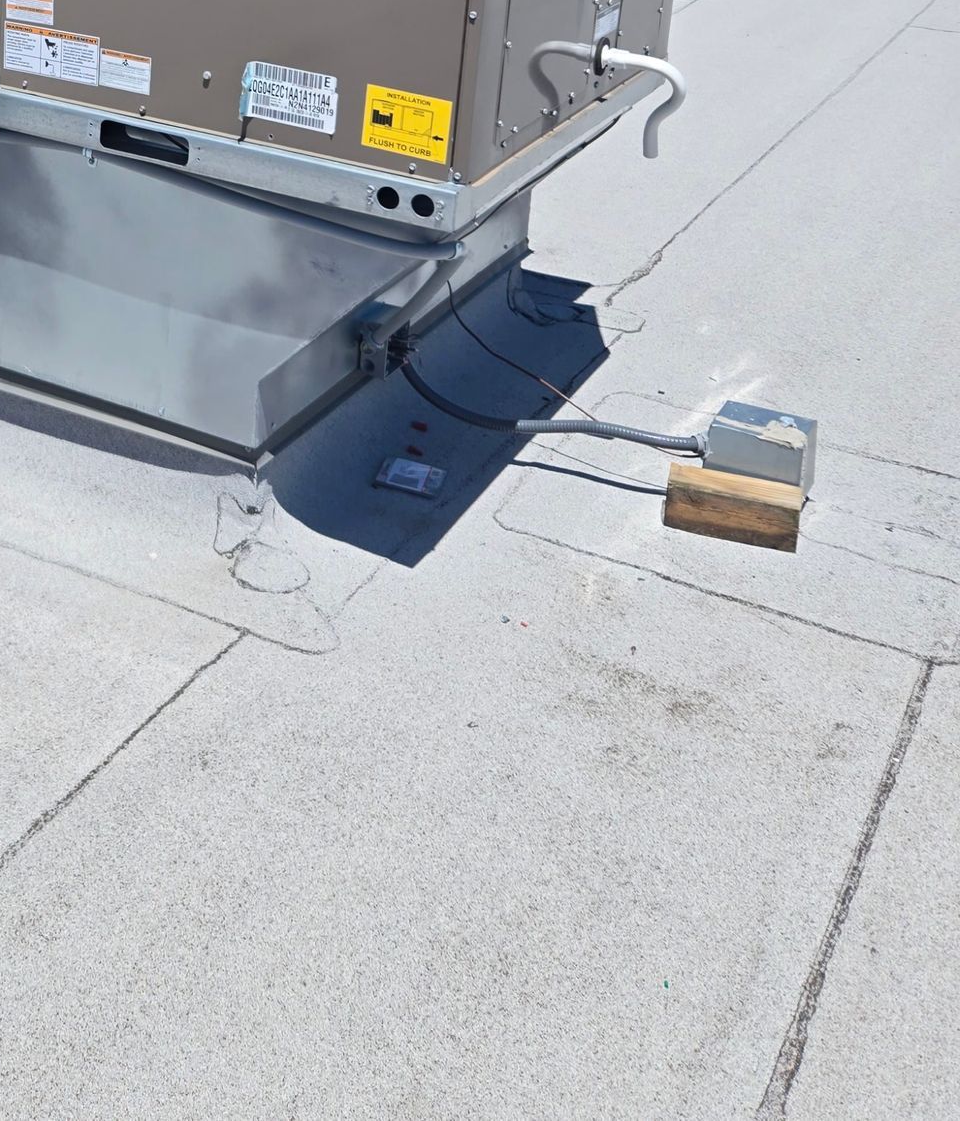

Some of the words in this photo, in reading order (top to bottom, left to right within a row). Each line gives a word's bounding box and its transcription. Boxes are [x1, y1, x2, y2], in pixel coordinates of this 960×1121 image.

[6, 24, 33, 33] WARNING
[324, 77, 331, 88] E
[387, 92, 431, 107] INSTALLATION
[369, 137, 395, 148] FLUSH
[395, 143, 407, 152] TO
[409, 147, 431, 157] CURB
